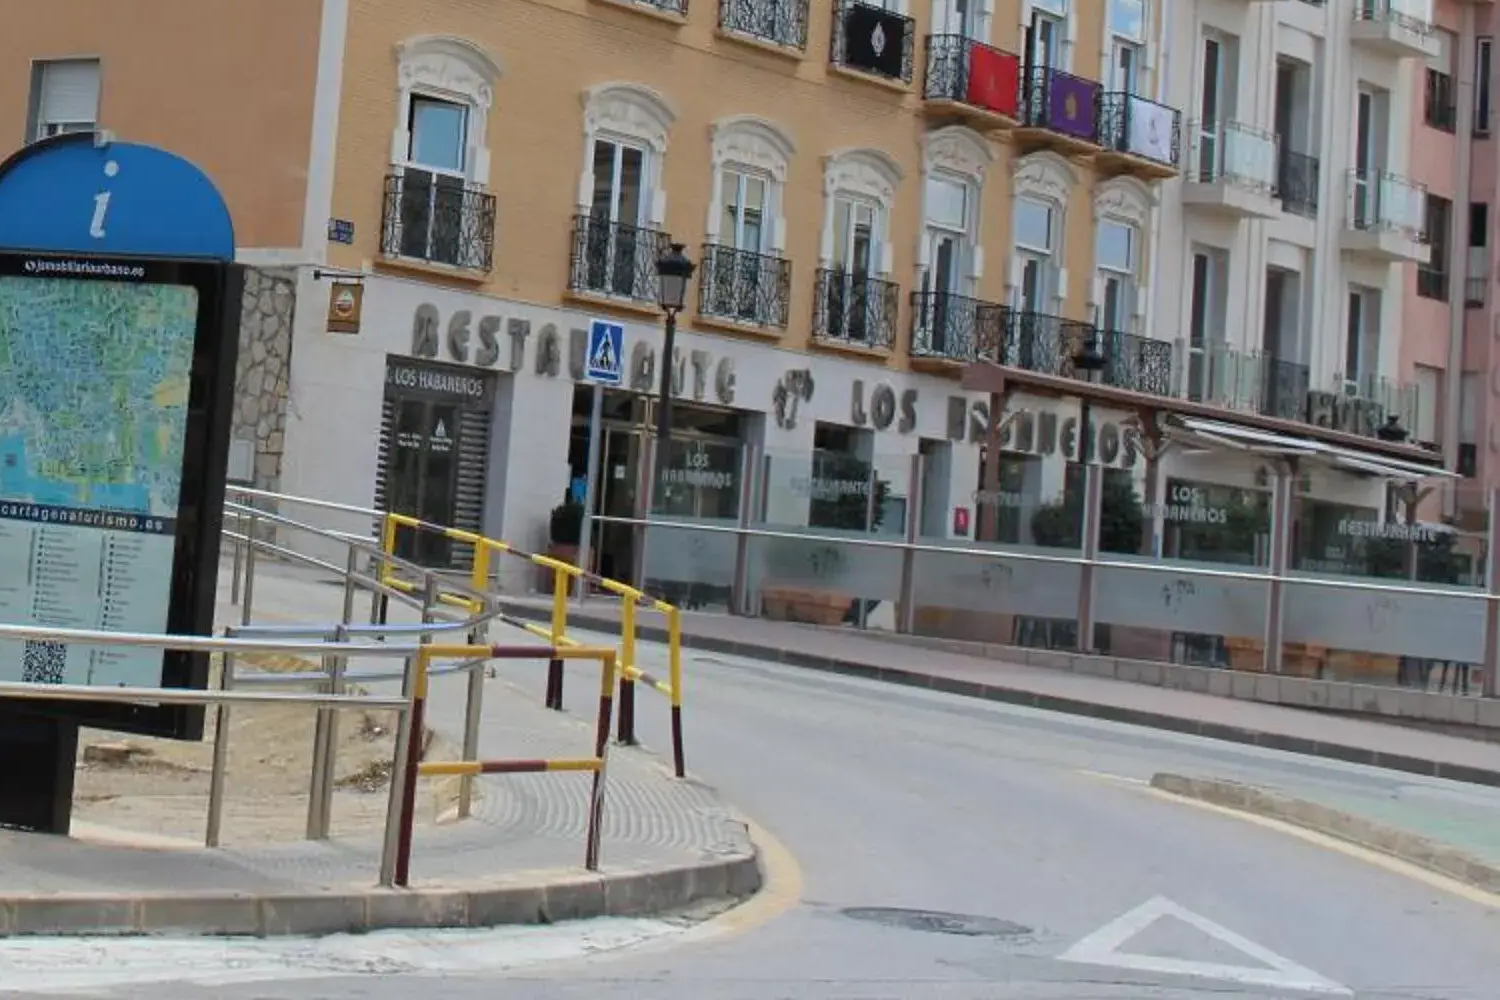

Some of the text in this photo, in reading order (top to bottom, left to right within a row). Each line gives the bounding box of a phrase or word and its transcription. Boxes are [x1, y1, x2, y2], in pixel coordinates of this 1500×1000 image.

[395, 367, 417, 387] LOS
[411, 302, 737, 405] RESTAUANTE
[851, 378, 918, 434] LOS
